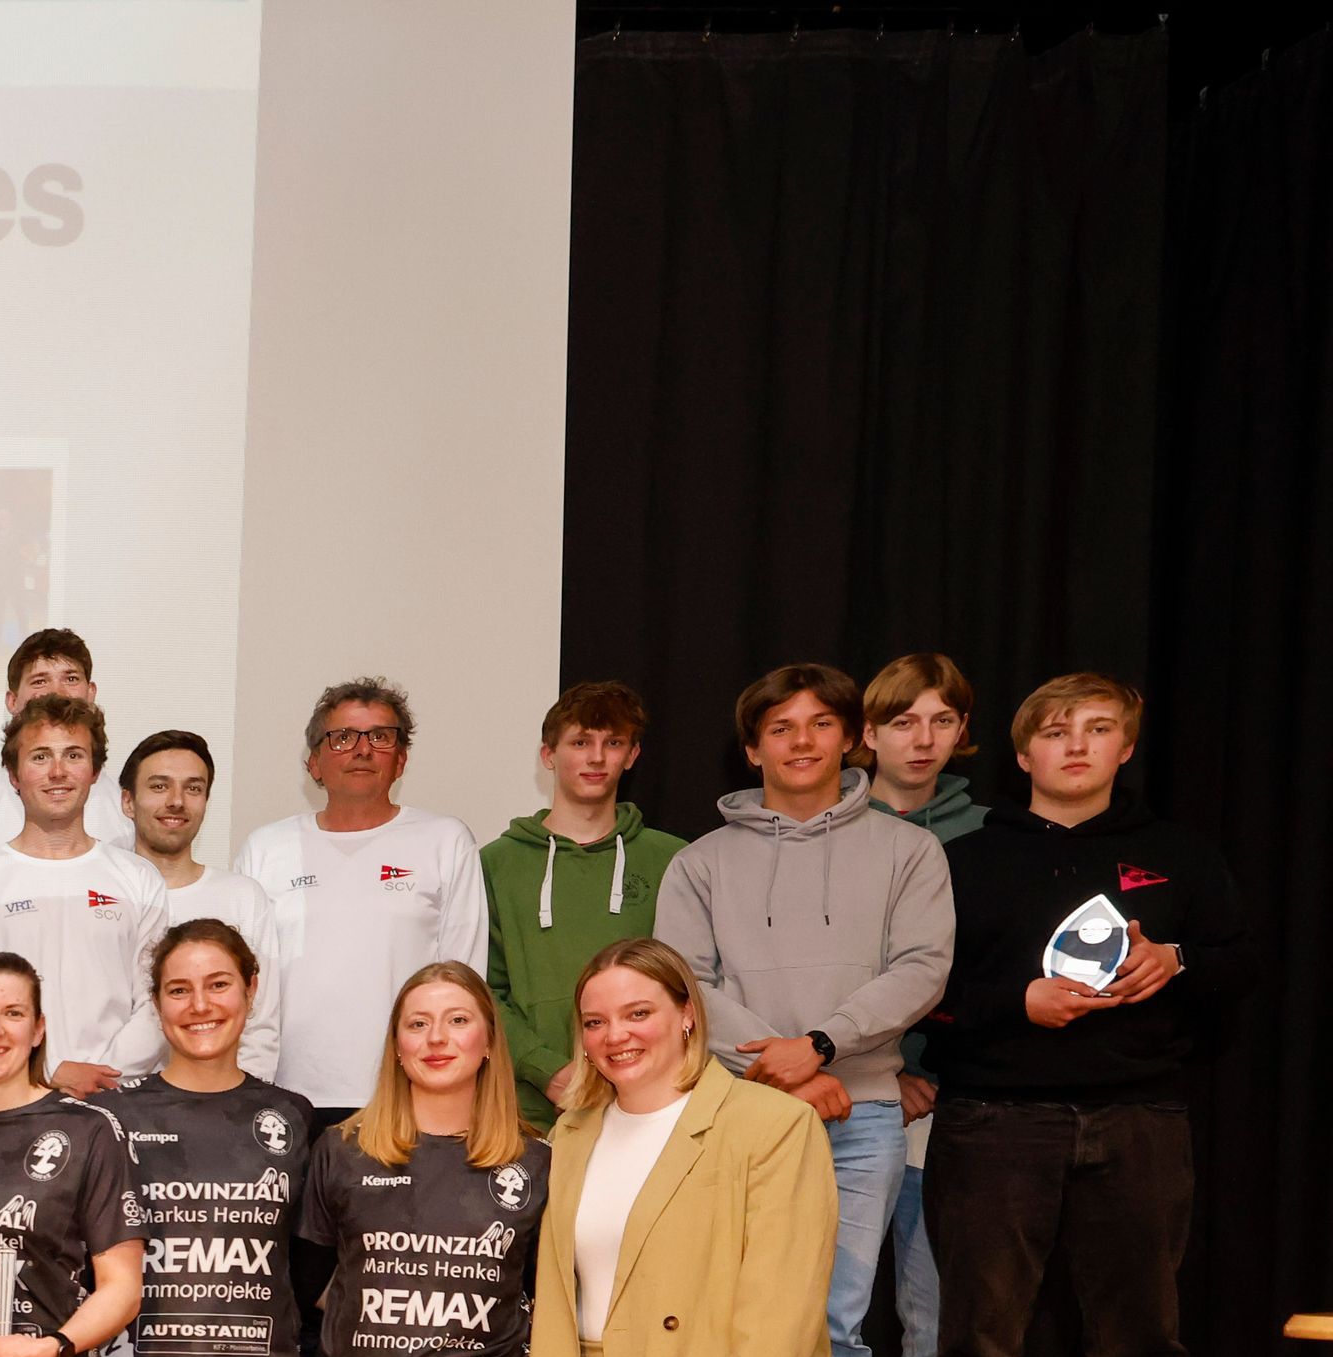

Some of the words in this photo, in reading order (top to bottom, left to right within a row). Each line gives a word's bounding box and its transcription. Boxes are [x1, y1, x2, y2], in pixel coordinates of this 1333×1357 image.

[384, 880, 416, 892] SCV
[4, 899, 33, 913] VRT
[94, 908, 123, 921] SCV
[128, 1131, 179, 1144] Kempa
[362, 1175, 412, 1188] Kempa
[213, 1206, 280, 1225] Henkel
[363, 1231, 505, 1260] PROVINZIAL
[141, 1237, 273, 1276] REMAX
[362, 1257, 429, 1276] Markus
[434, 1260, 501, 1282] Henkel
[141, 1281, 272, 1303] mmoprojekte
[359, 1288, 498, 1333] REMAX
[141, 1324, 268, 1340] AUTOSTATION
